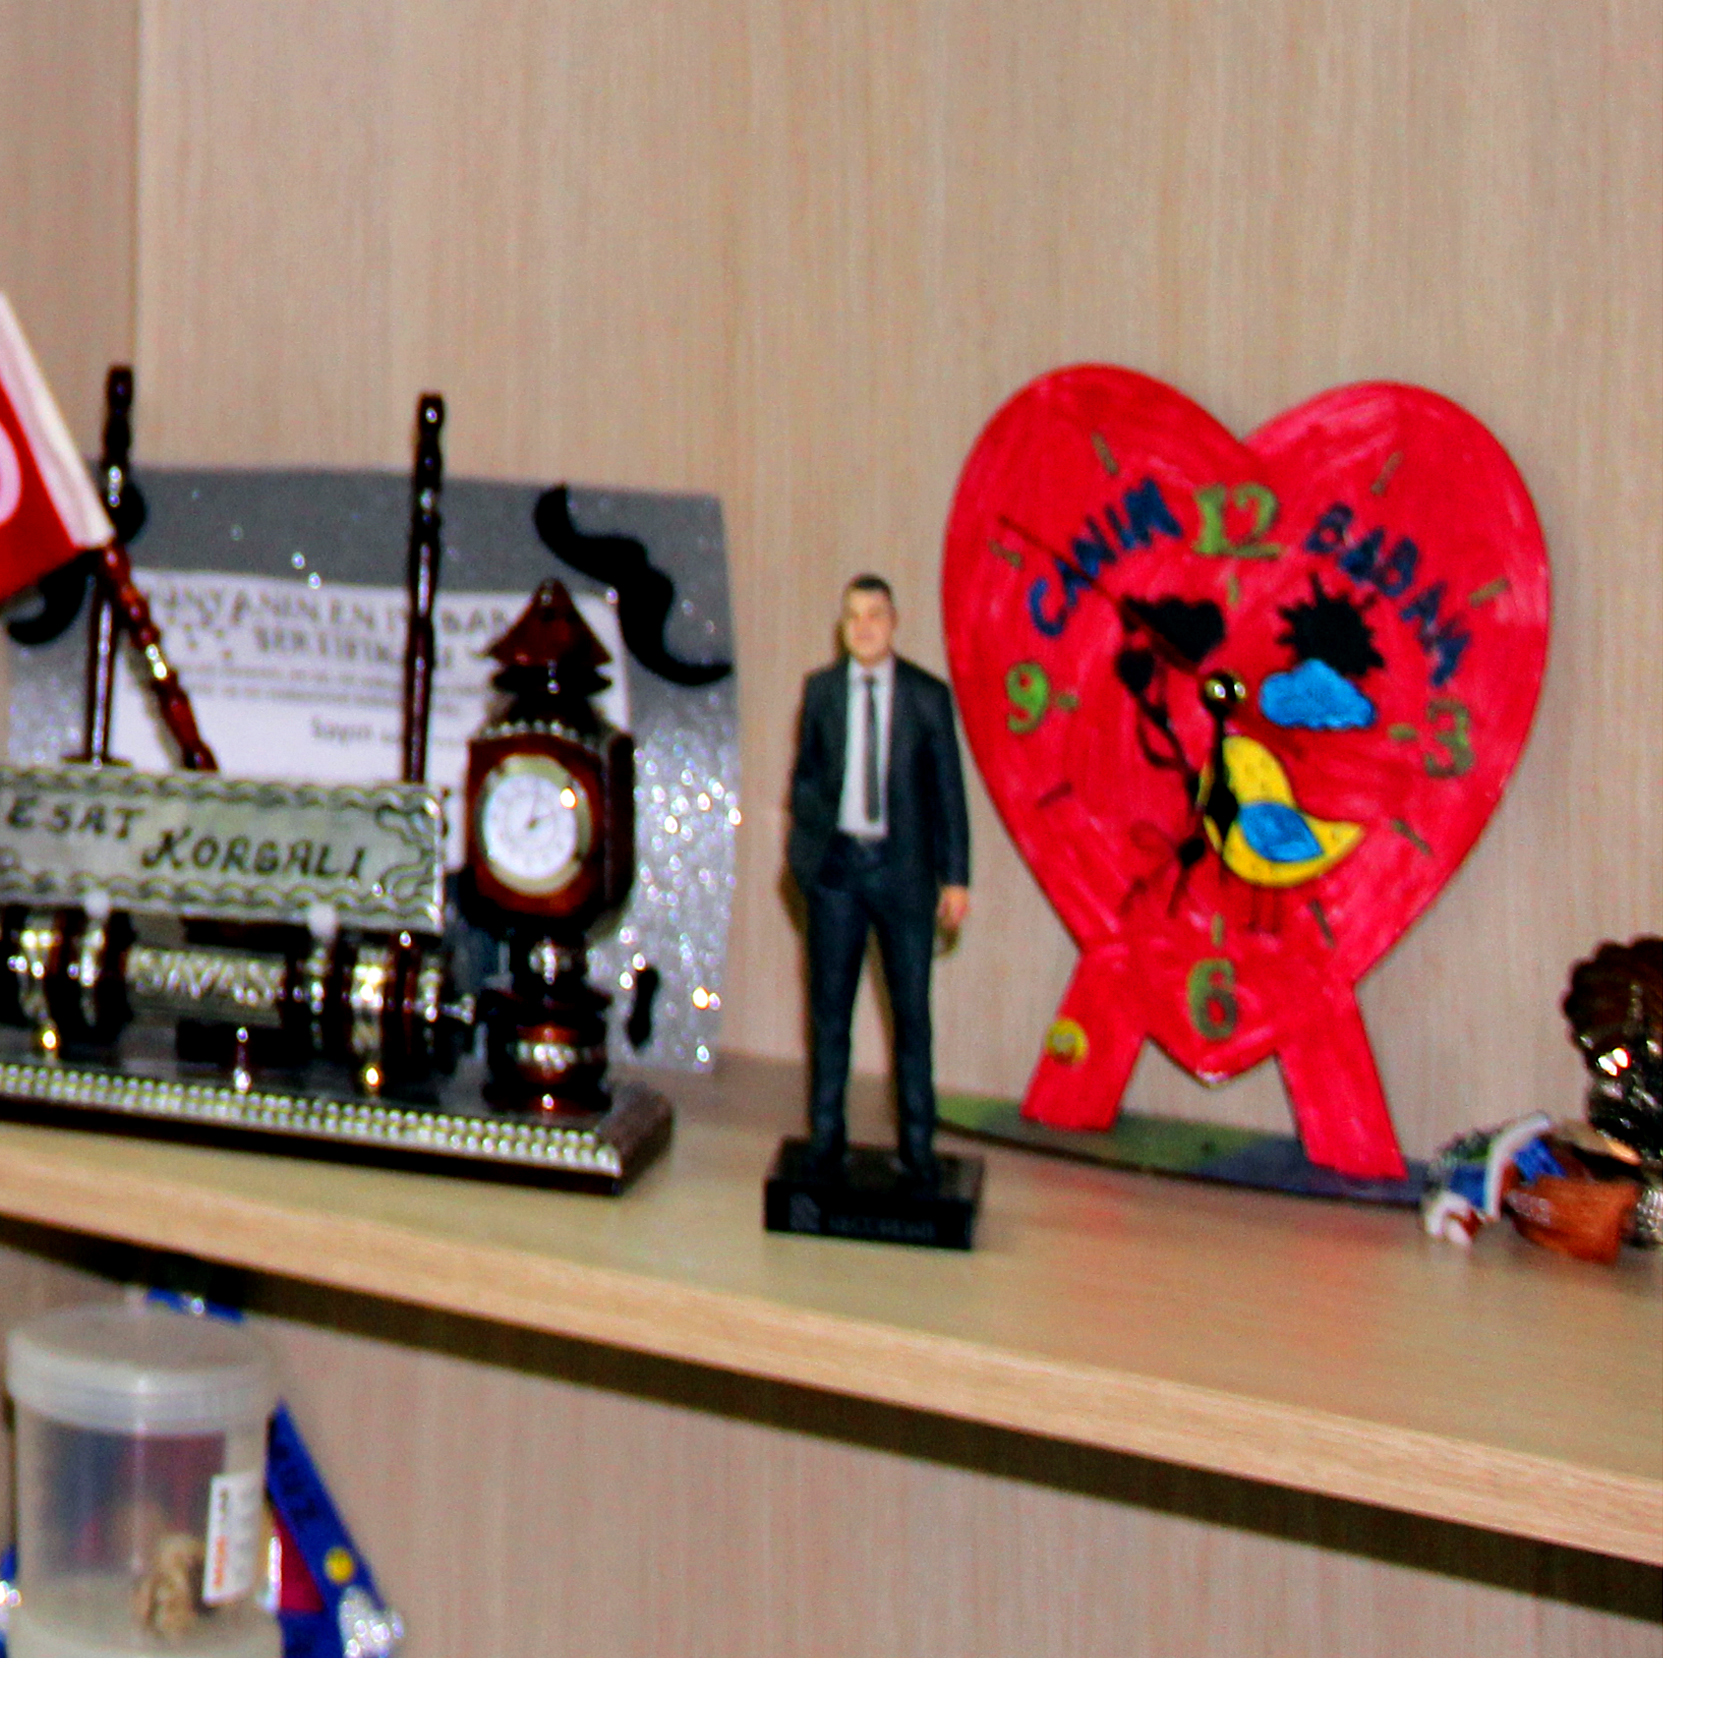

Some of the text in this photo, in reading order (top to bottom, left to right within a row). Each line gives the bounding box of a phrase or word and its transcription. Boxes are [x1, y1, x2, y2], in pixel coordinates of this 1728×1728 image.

[1193, 481, 1284, 559] 12
[1005, 660, 1050, 735] 9
[1423, 698, 1475, 779] 3
[6, 794, 144, 840] ESAT
[1187, 958, 1238, 1043] 6
